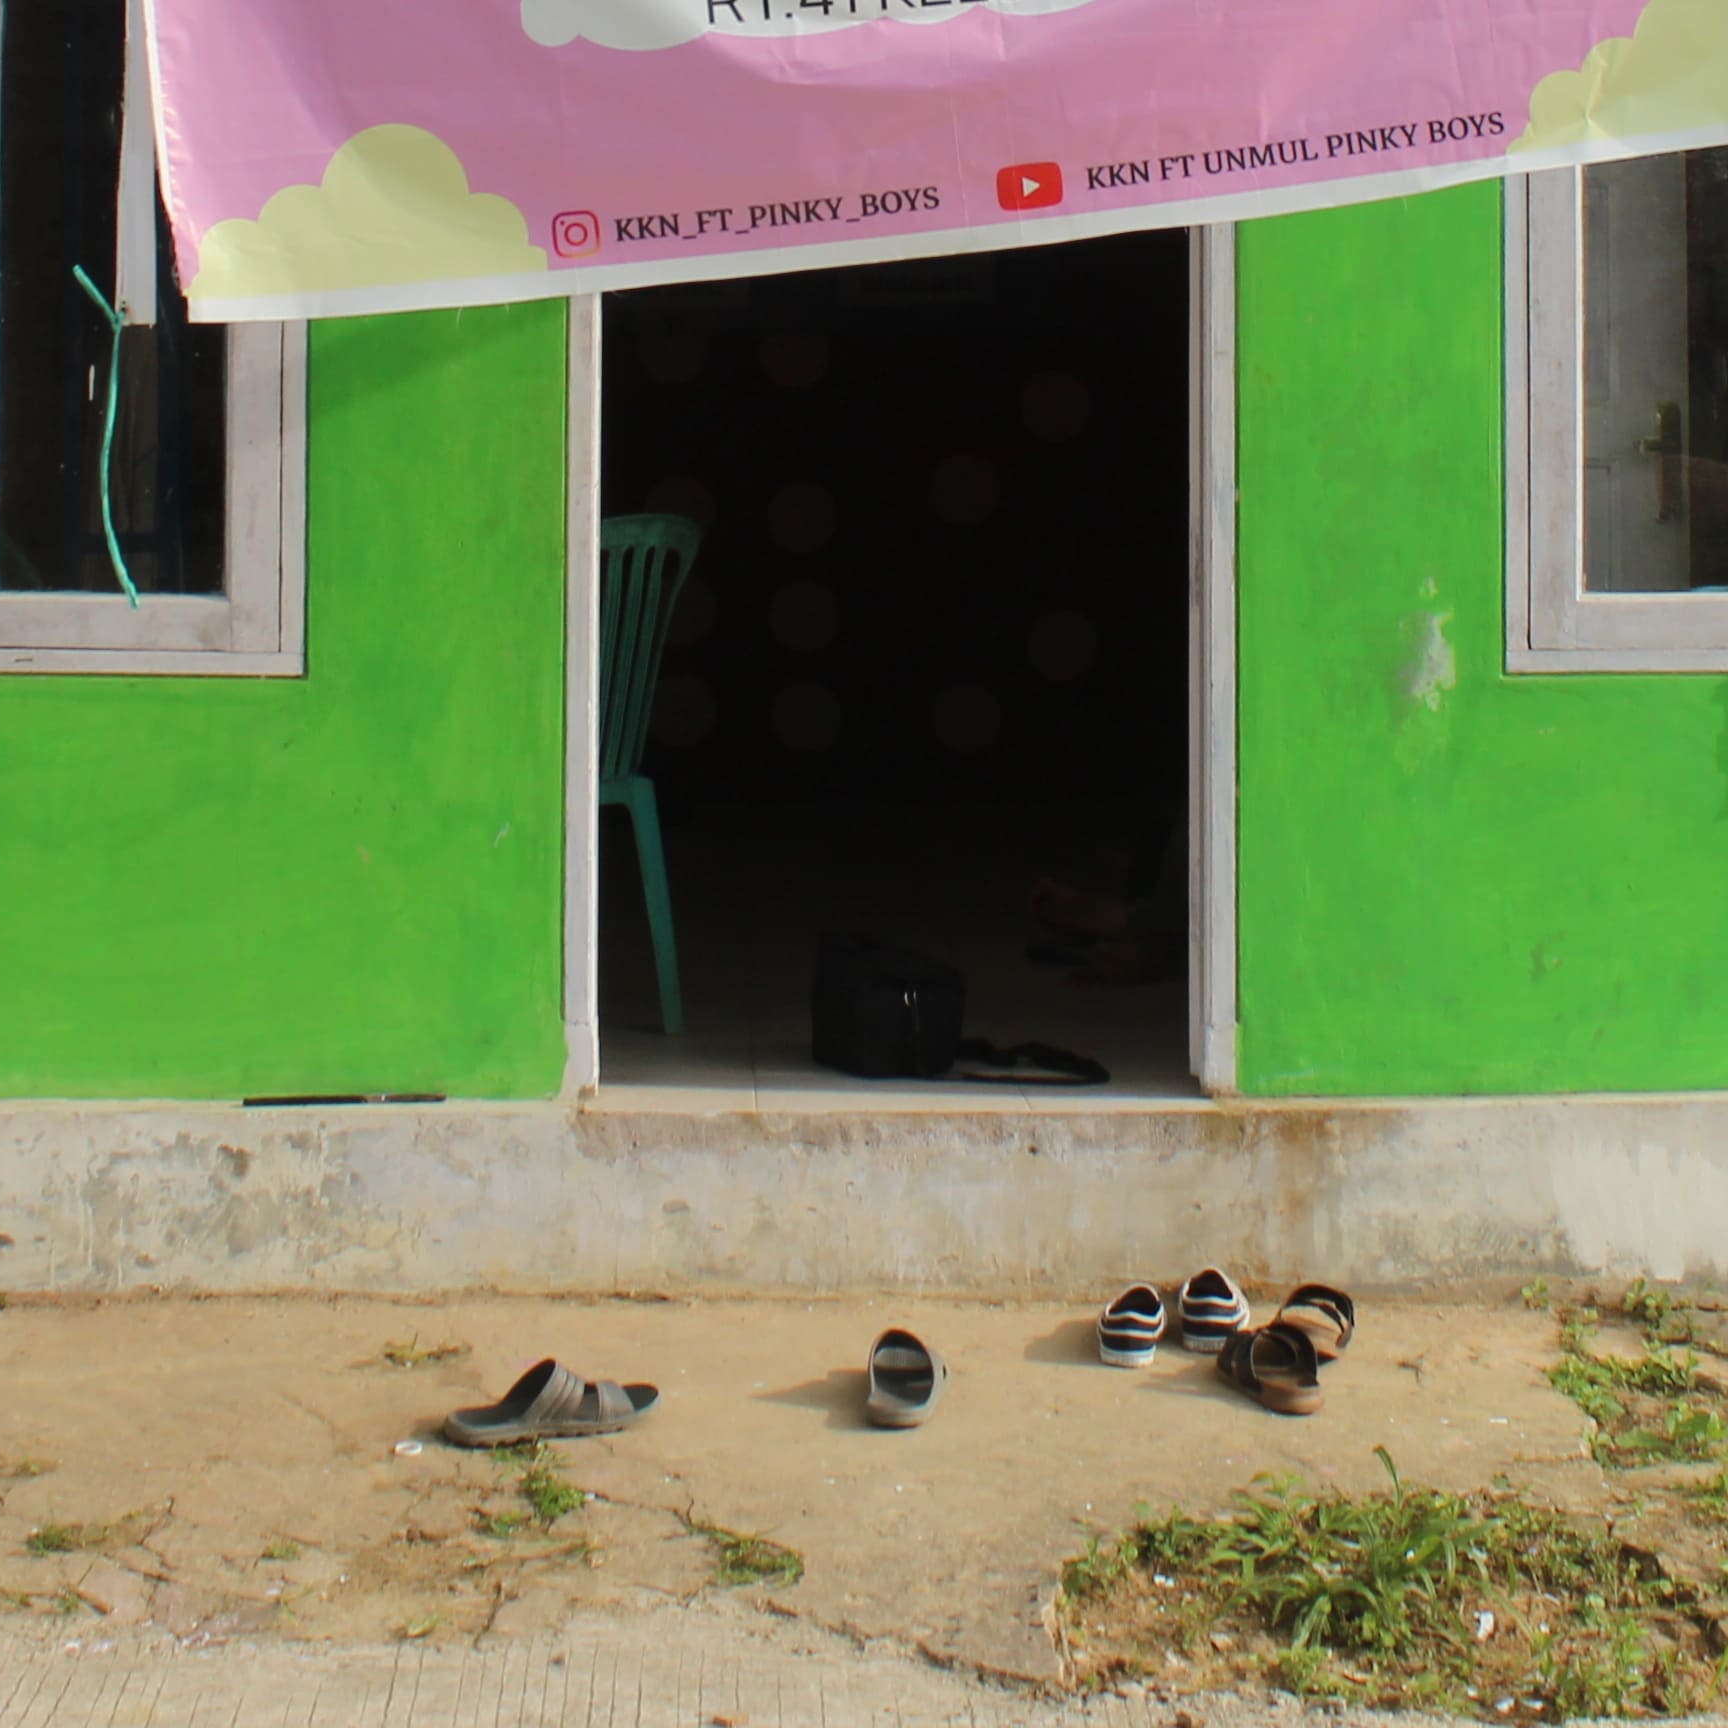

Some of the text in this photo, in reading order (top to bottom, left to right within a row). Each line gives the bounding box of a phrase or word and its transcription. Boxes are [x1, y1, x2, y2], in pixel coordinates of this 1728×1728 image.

[1085, 111, 1506, 191] KKN FT UNMUL PINKY BOYS
[614, 185, 941, 243] KKN_FT_PINKY_BOYS
